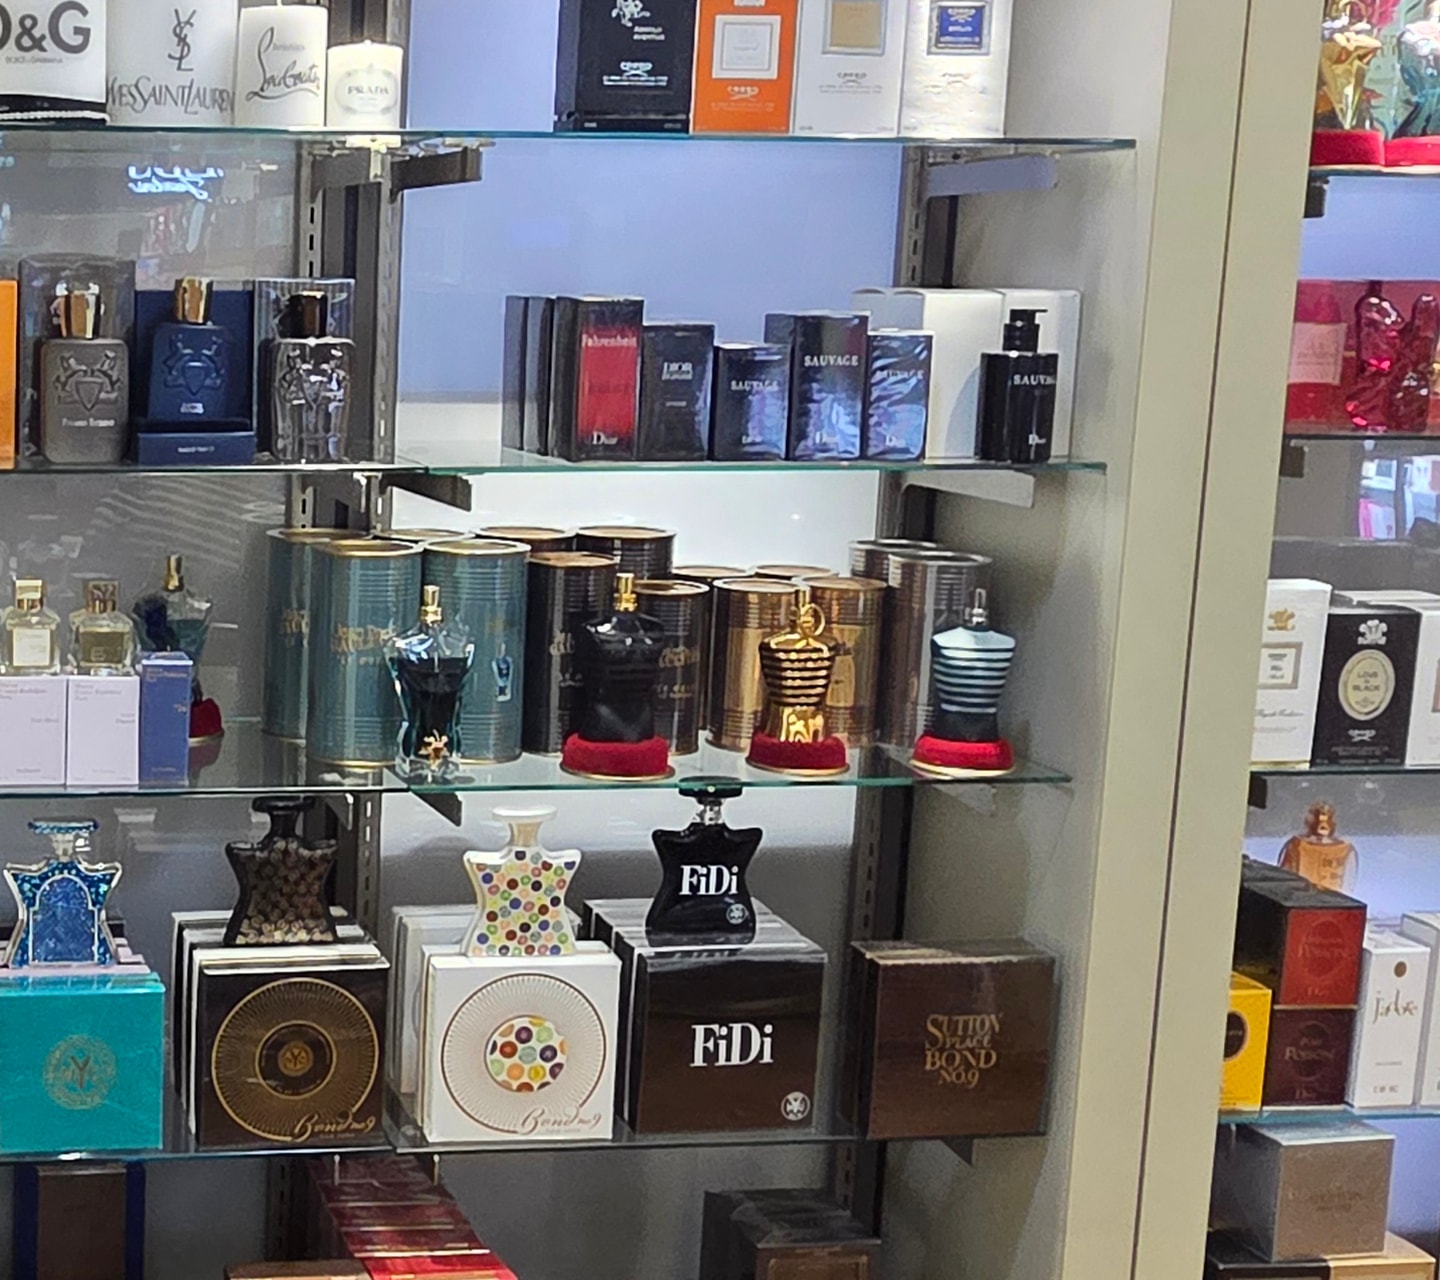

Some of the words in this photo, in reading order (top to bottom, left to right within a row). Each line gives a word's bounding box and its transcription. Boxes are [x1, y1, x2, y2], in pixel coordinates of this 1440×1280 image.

[582, 333, 638, 348] Fahrenheit
[804, 354, 859, 368] SAUVAGE
[679, 864, 740, 896] FiDi
[689, 1022, 775, 1068] FiDi
[925, 1049, 998, 1071] BOND
